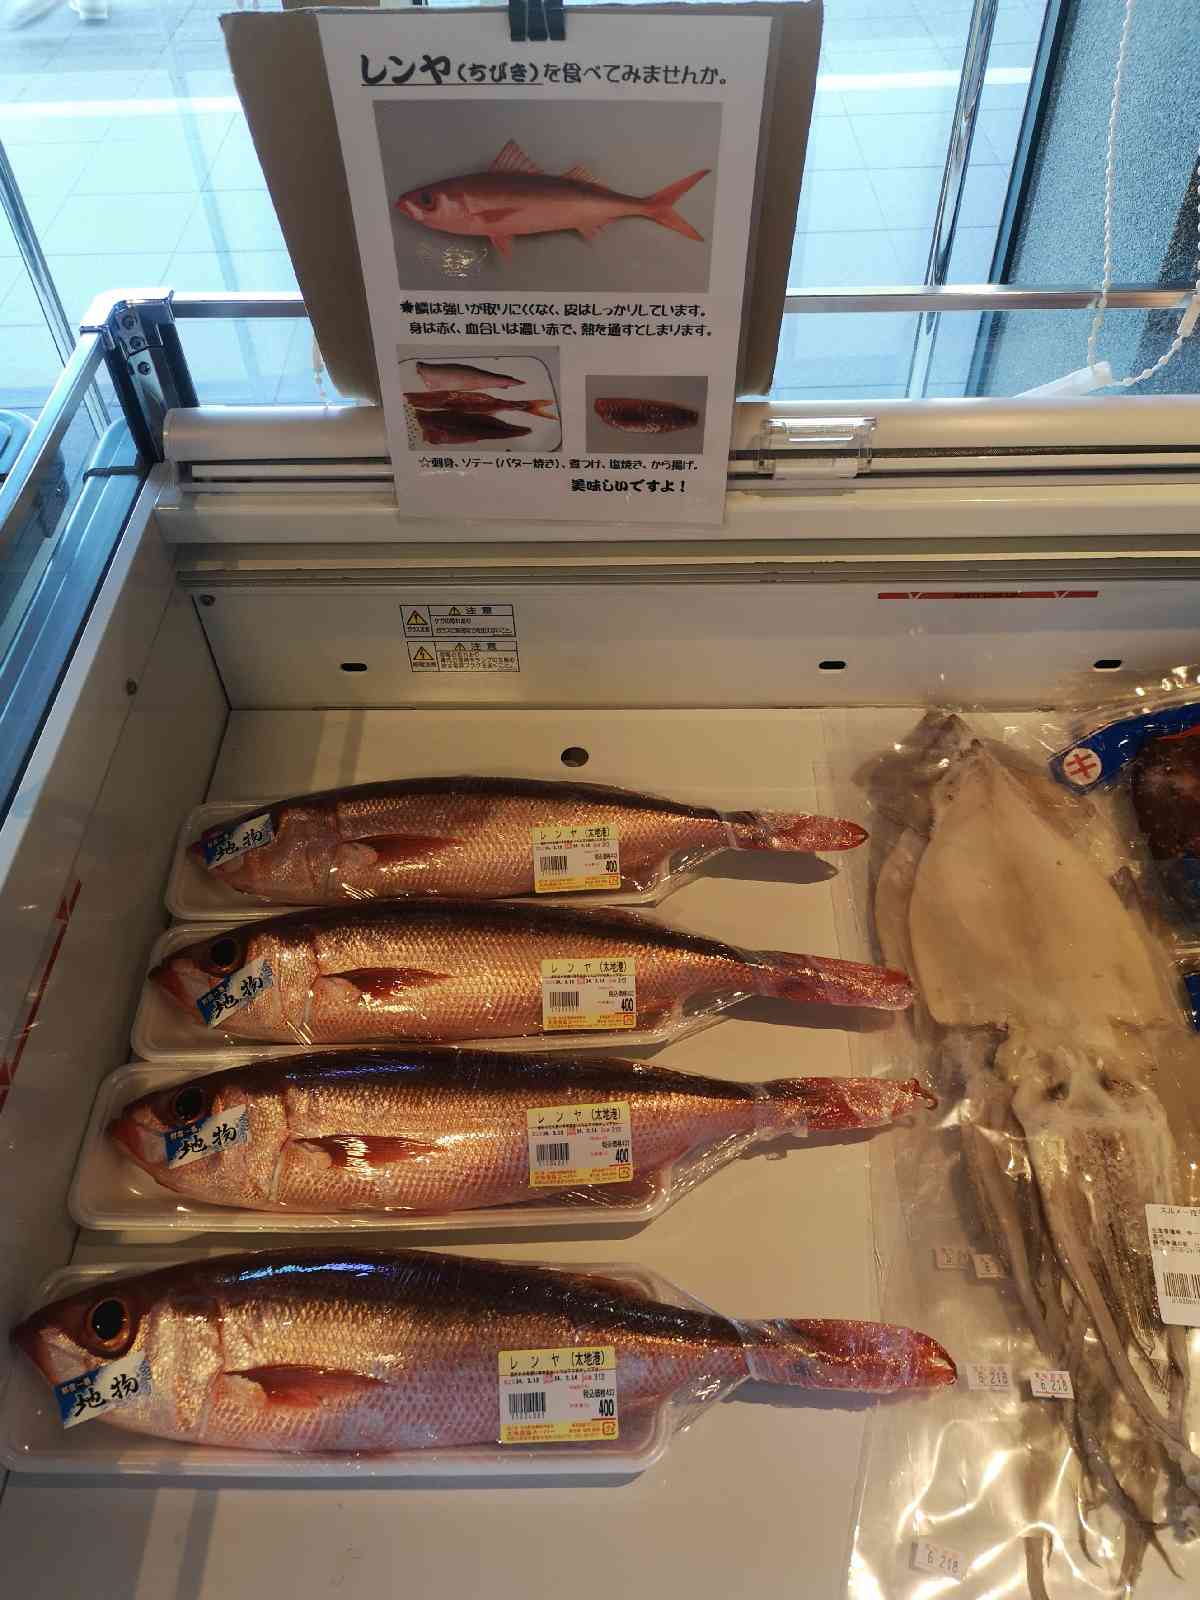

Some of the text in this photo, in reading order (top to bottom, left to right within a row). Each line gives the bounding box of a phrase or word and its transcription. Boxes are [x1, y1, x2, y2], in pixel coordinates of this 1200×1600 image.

[178, 1122, 237, 1160] 地物
[510, 1352, 560, 1370] レンヤ
[74, 1373, 139, 1417] 地物
[599, 1399, 615, 1417] 400
